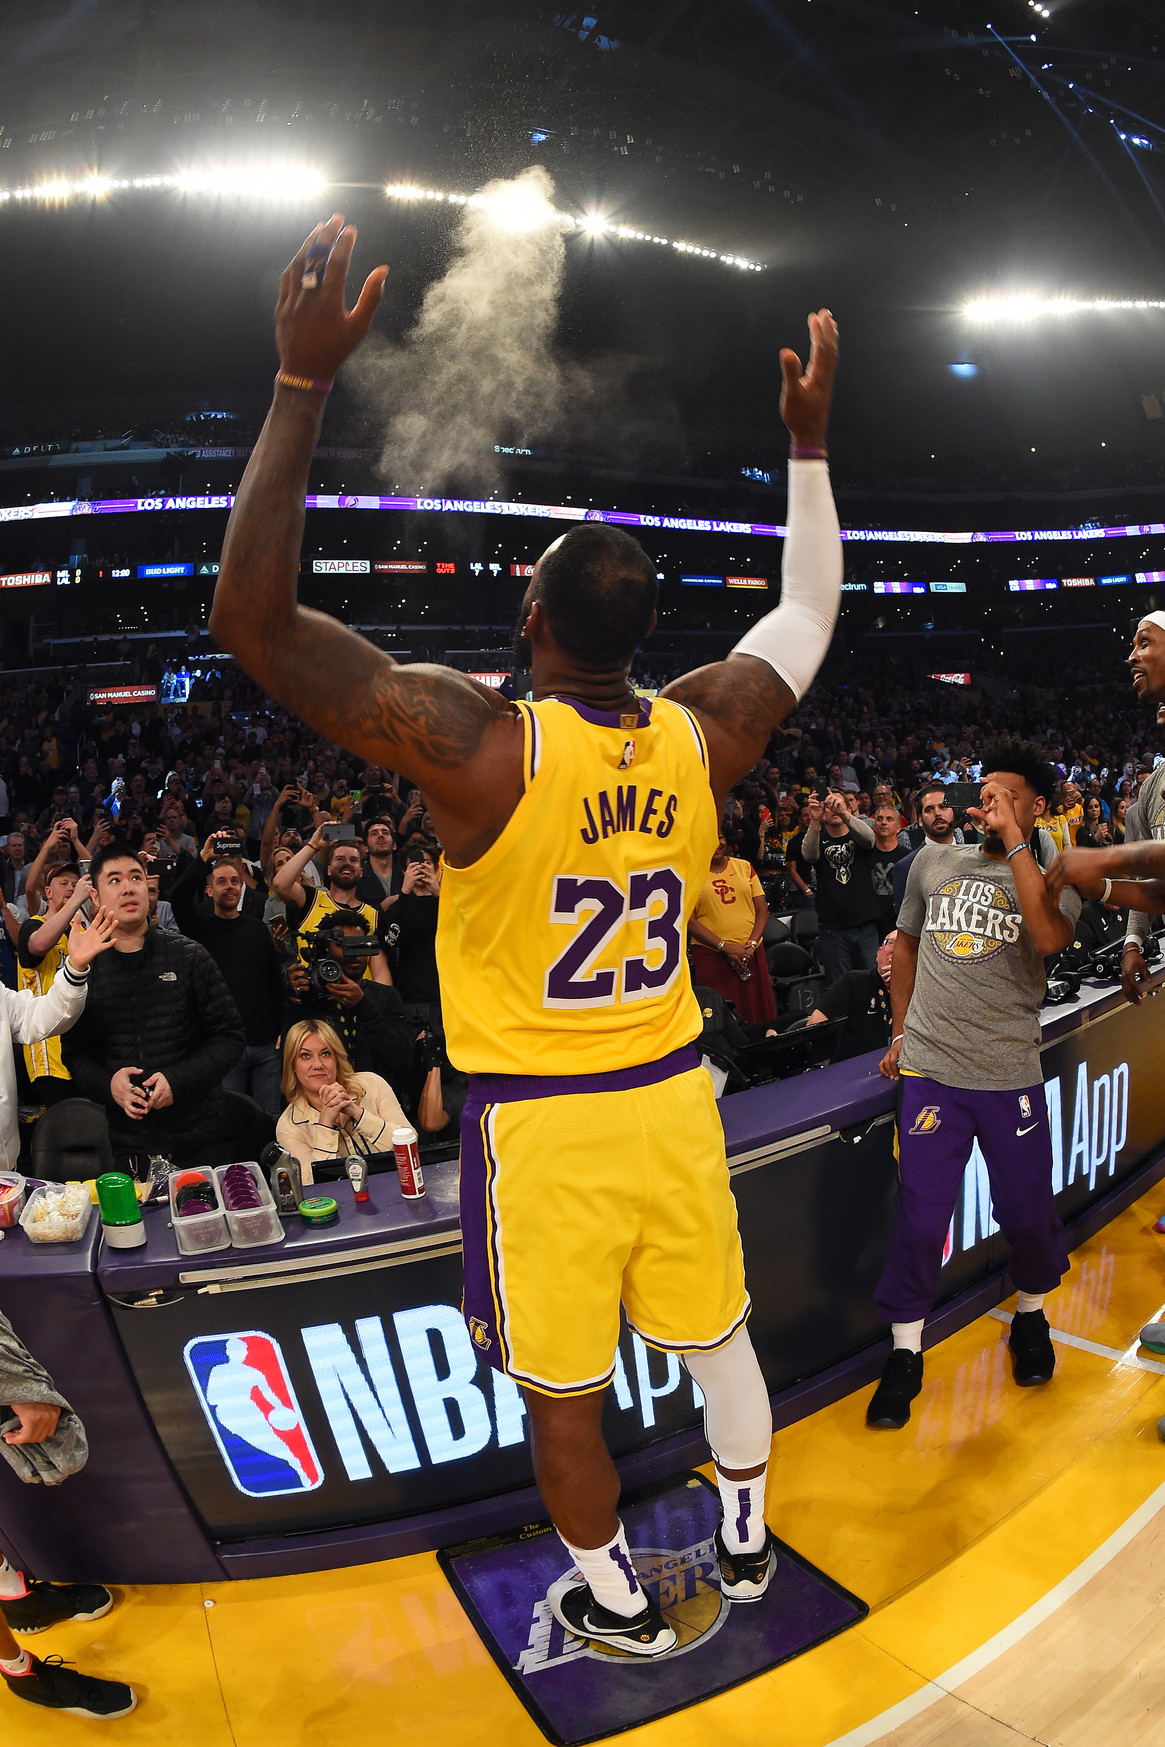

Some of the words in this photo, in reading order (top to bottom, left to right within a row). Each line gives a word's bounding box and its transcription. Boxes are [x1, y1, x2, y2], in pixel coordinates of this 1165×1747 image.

[137, 499, 163, 510] LOS
[165, 497, 228, 509] ANGELES
[416, 499, 442, 510] LOS
[444, 500, 502, 514] ANGELES
[505, 504, 550, 517] LAKERS
[640, 515, 661, 526] LOS
[663, 518, 712, 531] ANGELES
[713, 521, 752, 534] LAKERS
[846, 530, 866, 540] LOS
[867, 531, 910, 541] ANGELES
[1015, 531, 1032, 540] LOS
[1034, 530, 1072, 540] ANGELES
[1074, 528, 1106, 539] LAKERS
[111, 569, 130, 577] 12:00
[162, 566, 185, 574] LIGHT
[314, 561, 368, 572] STAPLES
[1, 573, 51, 586] TOSHIBA
[57, 577, 70, 585] LAL
[728, 578, 747, 586] WELLS
[1061, 578, 1095, 587] TOSHIBA
[133, 689, 156, 697] CASINO
[580, 785, 678, 845] JAMES
[216, 841, 241, 850] Supreme
[711, 879, 737, 904] SC
[957, 879, 996, 906] LOS
[925, 896, 1022, 943] LAKERS
[542, 864, 687, 1011] 23
[798, 988, 814, 1009] 13
[1067, 1061, 1129, 1191] App
[520, 1526, 552, 1540] Custom
[522, 1523, 540, 1532] The
